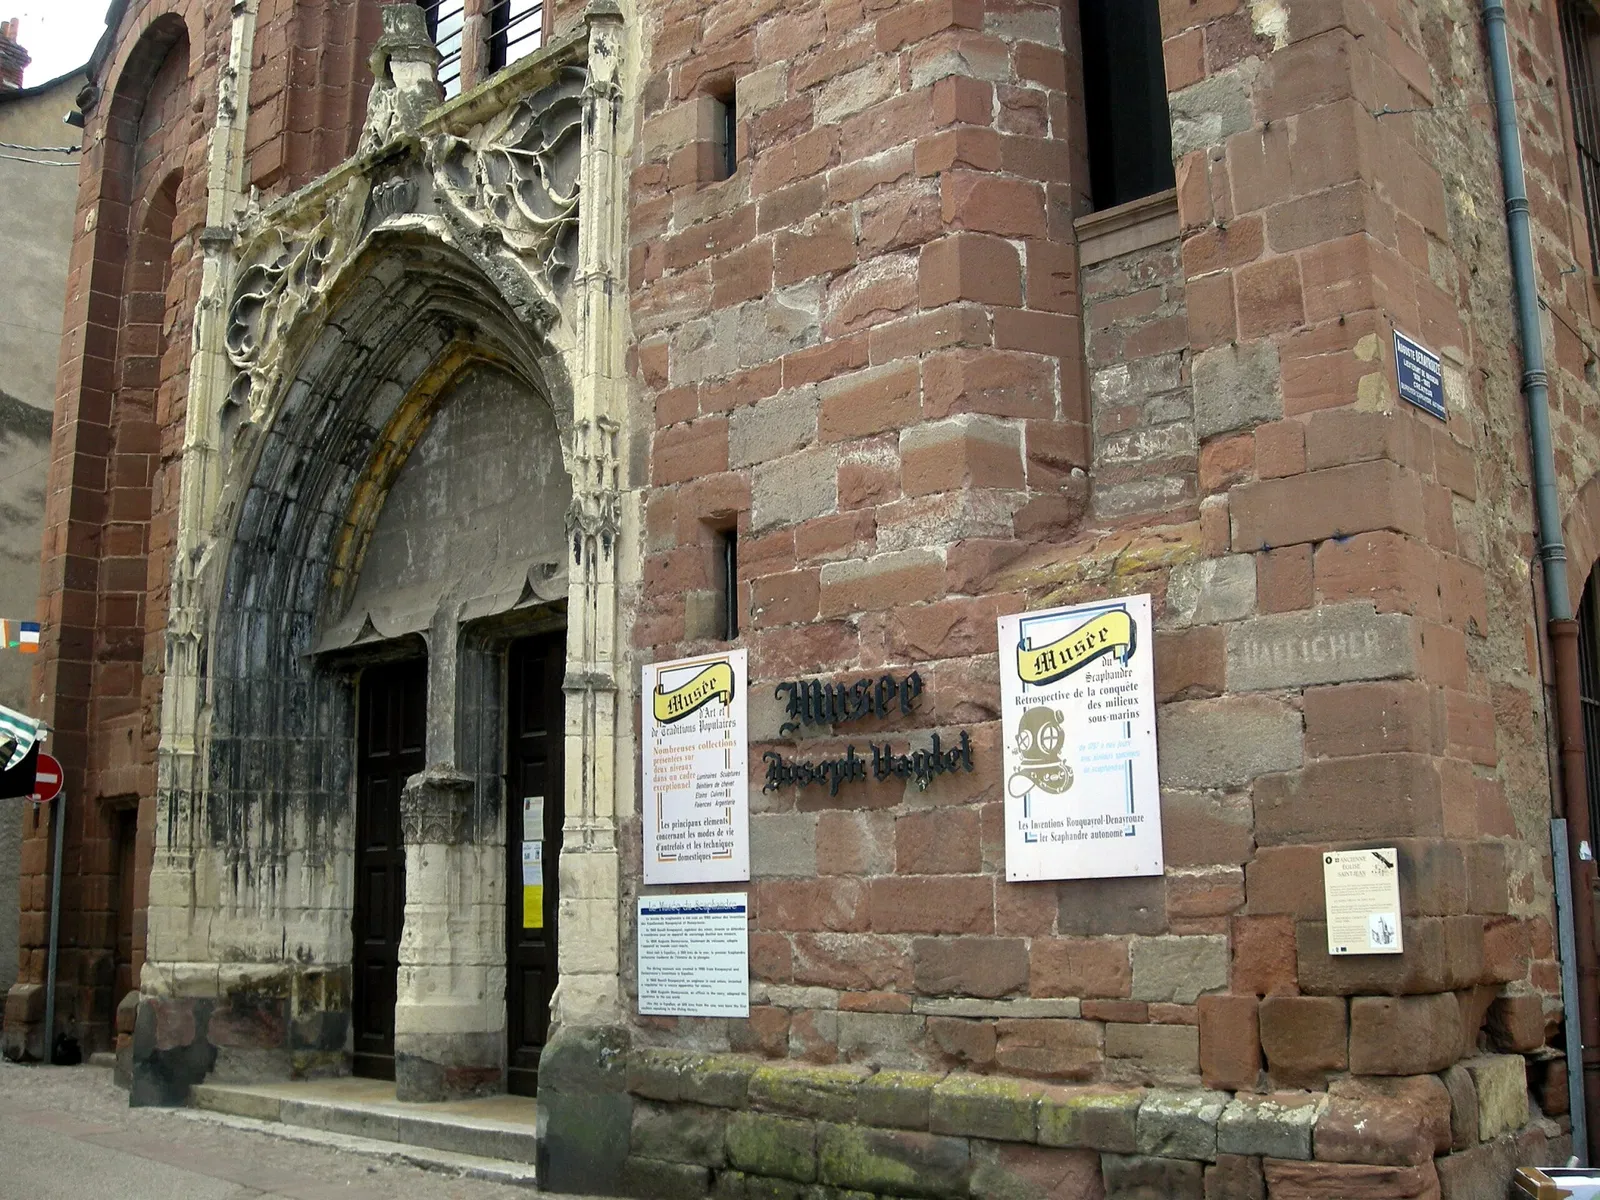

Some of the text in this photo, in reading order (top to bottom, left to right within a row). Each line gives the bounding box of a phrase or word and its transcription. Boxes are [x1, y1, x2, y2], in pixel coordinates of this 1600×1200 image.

[1034, 627, 1108, 675] Musée
[1102, 656, 1112, 666] du
[1085, 667, 1132, 683] Scaphandre
[668, 678, 716, 714] Musée
[1074, 688, 1083, 698] de
[1088, 687, 1095, 696] la
[1088, 696, 1139, 710] des milieux
[1088, 710, 1140, 723] sous-marins
[651, 727, 658, 737] de
[653, 740, 737, 755] Nombreuses collections
[670, 764, 692, 772] niveaux
[680, 771, 695, 780] cadre
[653, 780, 690, 792] exceptionnel
[661, 821, 670, 829] Les
[672, 819, 701, 830] principaux
[1018, 820, 1028, 830] Les
[1031, 819, 1064, 829] Inventions
[656, 831, 685, 840] concernant
[698, 829, 715, 838] modes
[717, 828, 724, 836] de
[726, 827, 734, 836] vie
[1050, 830, 1088, 844] Scaphandre
[1090, 829, 1123, 839] autonome
[656, 842, 684, 851] d'autrefois
[703, 840, 734, 850] techniques
[678, 852, 711, 863] domestiques
